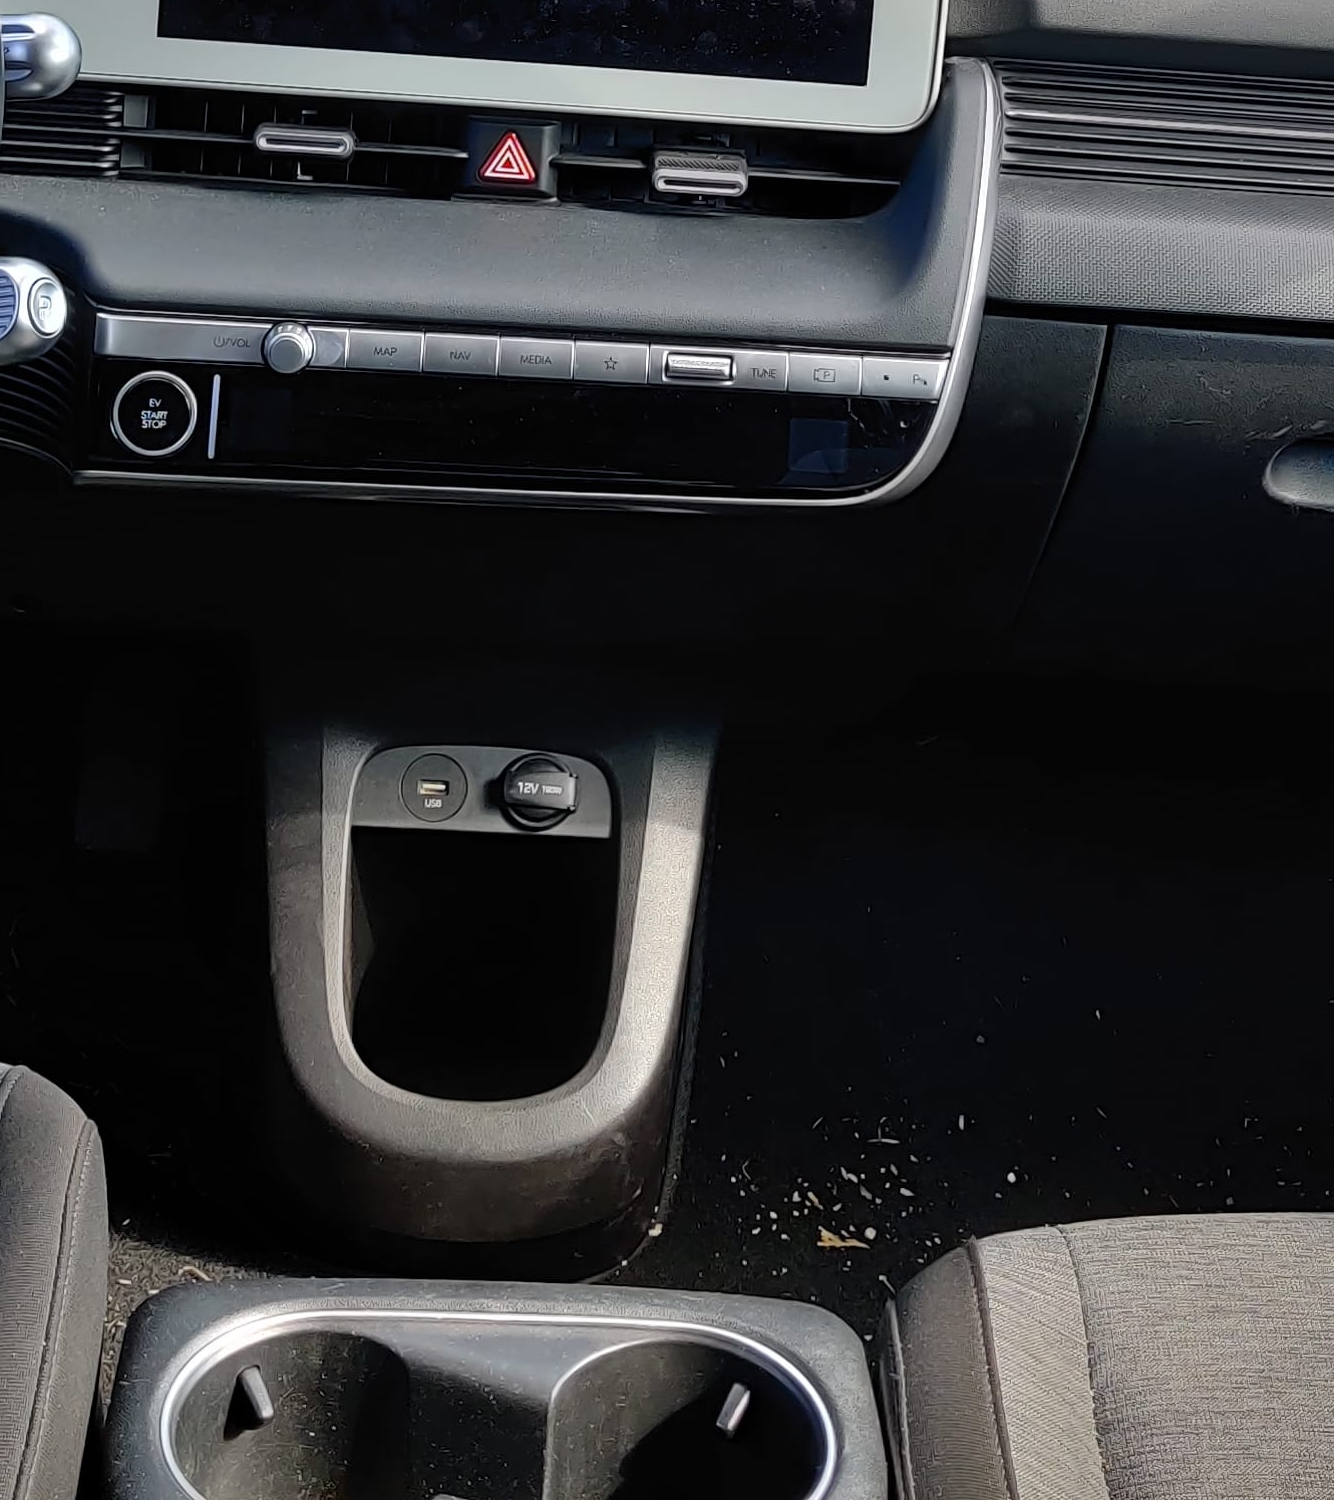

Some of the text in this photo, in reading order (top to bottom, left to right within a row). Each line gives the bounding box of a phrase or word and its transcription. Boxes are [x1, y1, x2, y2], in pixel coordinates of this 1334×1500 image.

[373, 346, 398, 357] MAP
[449, 350, 471, 361] NAV
[519, 354, 553, 366] MEDIA
[750, 367, 777, 379] TUNE
[149, 398, 162, 407] EV
[140, 410, 168, 420] START
[141, 420, 167, 429] STOP
[517, 781, 540, 795] 12V
[424, 798, 442, 808] USB
